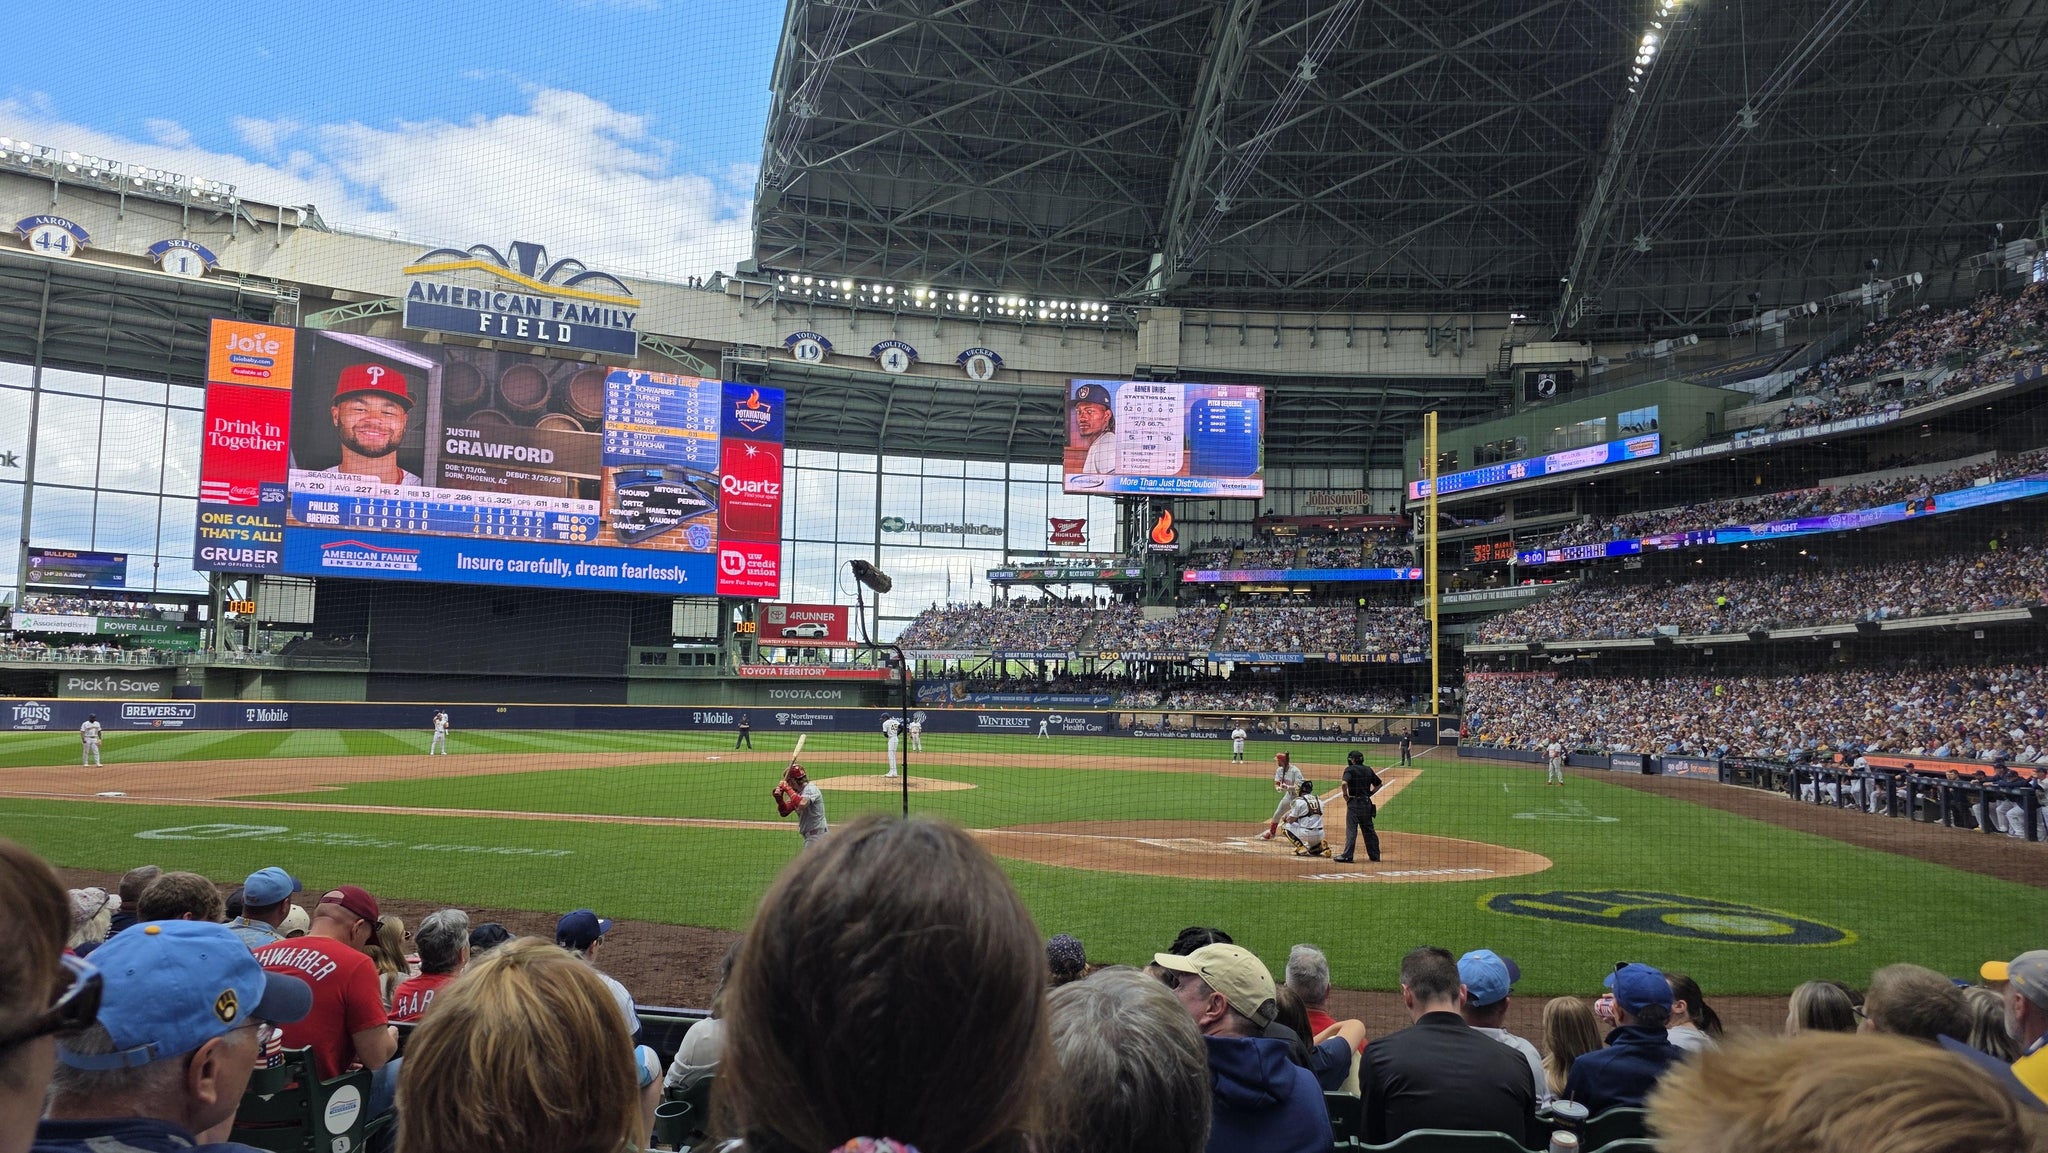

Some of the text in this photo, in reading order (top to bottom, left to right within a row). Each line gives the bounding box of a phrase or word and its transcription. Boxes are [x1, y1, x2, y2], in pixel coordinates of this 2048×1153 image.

[35, 217, 73, 230] AARON
[36, 232, 68, 254] 44
[167, 240, 200, 253] SELIG
[407, 281, 636, 329] AMERICAN FAMILY
[480, 313, 571, 342] FIELD
[796, 333, 823, 342] YOUNT
[225, 333, 281, 355] Joie
[878, 341, 911, 353] MOLITOR
[799, 345, 818, 359] 19
[966, 349, 993, 357] UECKER
[1134, 385, 1151, 393] ABNER
[635, 394, 660, 402] TURNER
[634, 401, 660, 411] HARPER
[634, 417, 656, 425] MARSH
[735, 409, 771, 422] POTAWATOMI
[215, 418, 281, 437] Drink in
[445, 427, 480, 438] JUSTIN
[634, 432, 656, 440] STOTT
[1676, 449, 1692, 459] REPORT
[1734, 439, 1746, 449] TEXT
[1804, 425, 1819, 437] ISSUE
[1820, 423, 1831, 434] AND
[1832, 418, 1857, 433] LOCATION
[1858, 417, 1865, 427] TO
[208, 432, 285, 452] Together
[445, 439, 554, 465] CRAWFORD
[633, 448, 647, 456] HILL
[466, 474, 497, 483] PHOENIX,
[506, 471, 530, 479] DEBUT:
[309, 482, 325, 490] 210
[721, 474, 779, 495] Quartz
[1119, 478, 1139, 486] More
[1158, 479, 1175, 487] Just
[1176, 480, 1219, 488] Distribution!
[421, 491, 431, 499] 13
[618, 489, 649, 497] CHOURIO
[654, 486, 688, 495] MITCHELL
[677, 498, 706, 506] PERKINS
[1306, 490, 1369, 506] Johnsonville
[308, 501, 339, 512] PHILLIES
[645, 507, 682, 516] HAMILTON
[609, 508, 640, 517] RENGIFO
[202, 512, 282, 528] ONE CALL...
[306, 513, 340, 525] BREWERS
[649, 516, 678, 525] VAUGHN
[1771, 511, 1882, 533] NIGHT June 17
[612, 521, 646, 531] SÁNCHEZ
[908, 522, 1003, 536] Aurora Health Care
[200, 527, 282, 543] THAT'S ALL!
[201, 547, 279, 564] GRUBER
[323, 550, 418, 563] AMERICAN FAMILY
[747, 553, 762, 561] uw
[1524, 553, 1542, 562] 3:00
[330, 560, 410, 569] INSURANCE
[457, 553, 688, 585] Insure carefully, dream fearlessly.
[747, 560, 776, 569] credit
[747, 568, 776, 577] union
[1443, 595, 1458, 604] OFFICIAL
[1472, 593, 1482, 601] PIZZA
[1496, 590, 1517, 599] MILWAUKEE
[1517, 588, 1536, 597] BREWERS
[230, 601, 255, 613] 0:08
[789, 611, 835, 622] 4RUNNER
[104, 622, 167, 633] POWER ALLEY
[1100, 651, 1151, 660] 620 WTMJ
[1340, 654, 1387, 662] NICOLET LAW
[741, 667, 827, 676] TOYOTA TERRITORY
[68, 678, 160, 692] Pick Save
[769, 689, 842, 699] TOYOTA.COM
[12, 707, 51, 722] TRUSS
[126, 706, 191, 717] BREWERS.TV
[256, 709, 289, 722] Mobile
[702, 712, 733, 724] Mobile
[978, 715, 1031, 726] WINTRUST
[1063, 717, 1086, 725] Aurora
[1086, 724, 1103, 732] Care
[1298, 872, 1376, 880] VOTE
